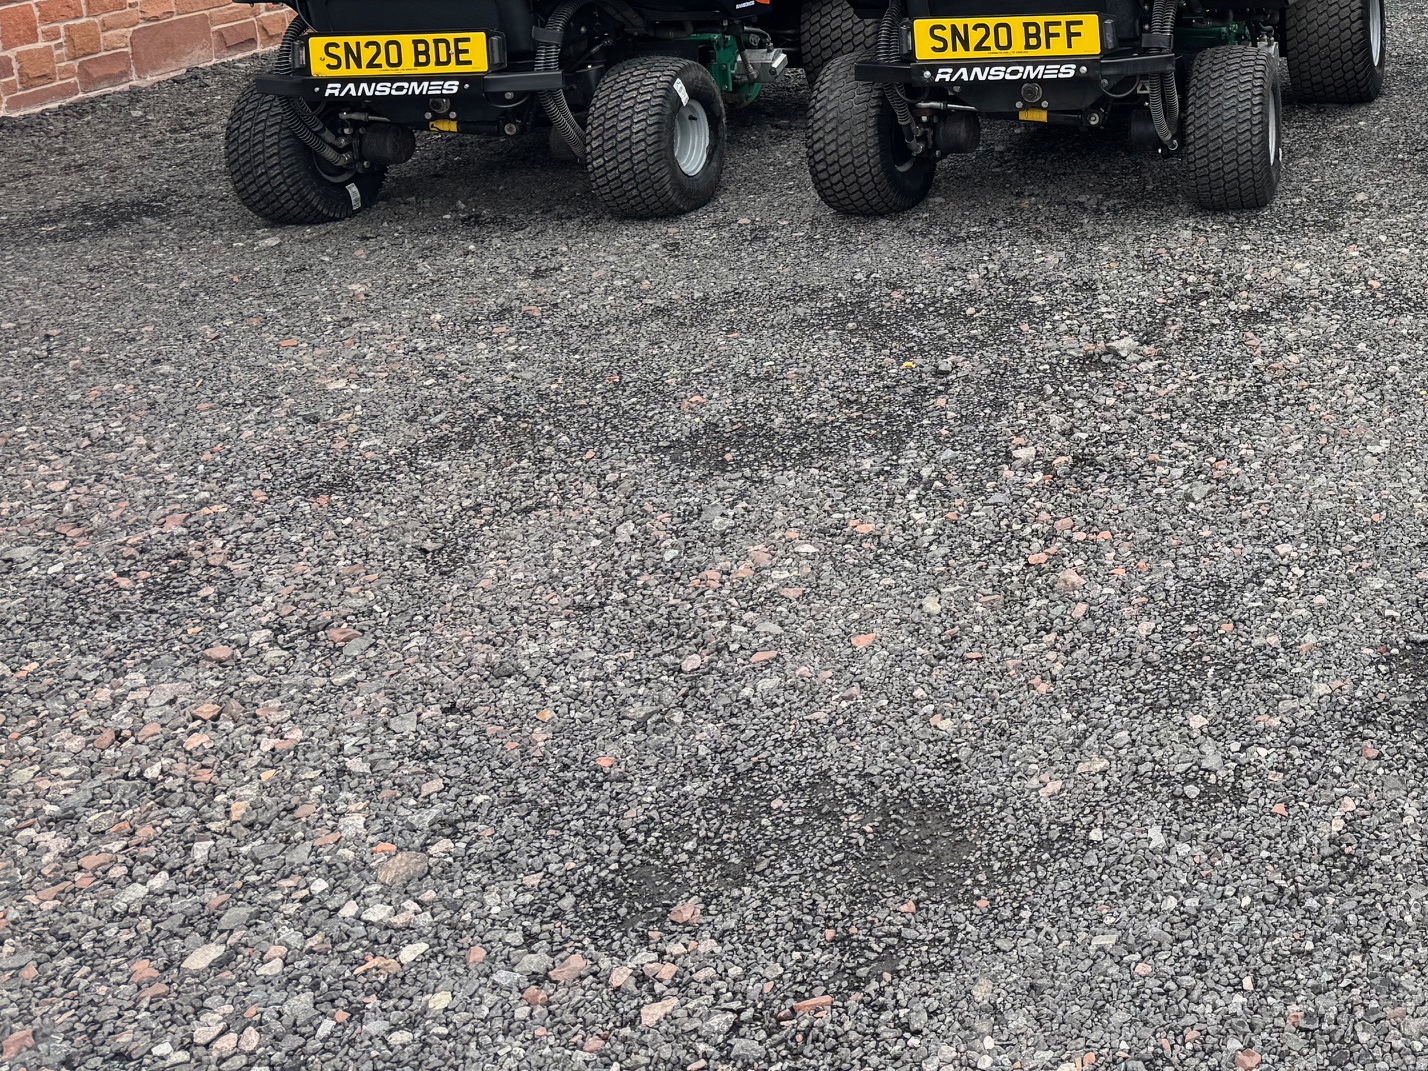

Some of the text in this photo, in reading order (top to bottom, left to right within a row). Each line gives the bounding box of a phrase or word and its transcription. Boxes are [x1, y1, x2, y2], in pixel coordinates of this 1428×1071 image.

[929, 20, 1083, 53] SN20 BFF
[324, 37, 473, 70] SN20 BDE
[934, 63, 1077, 82] RANSOMES
[324, 80, 460, 97] RANSOMES
